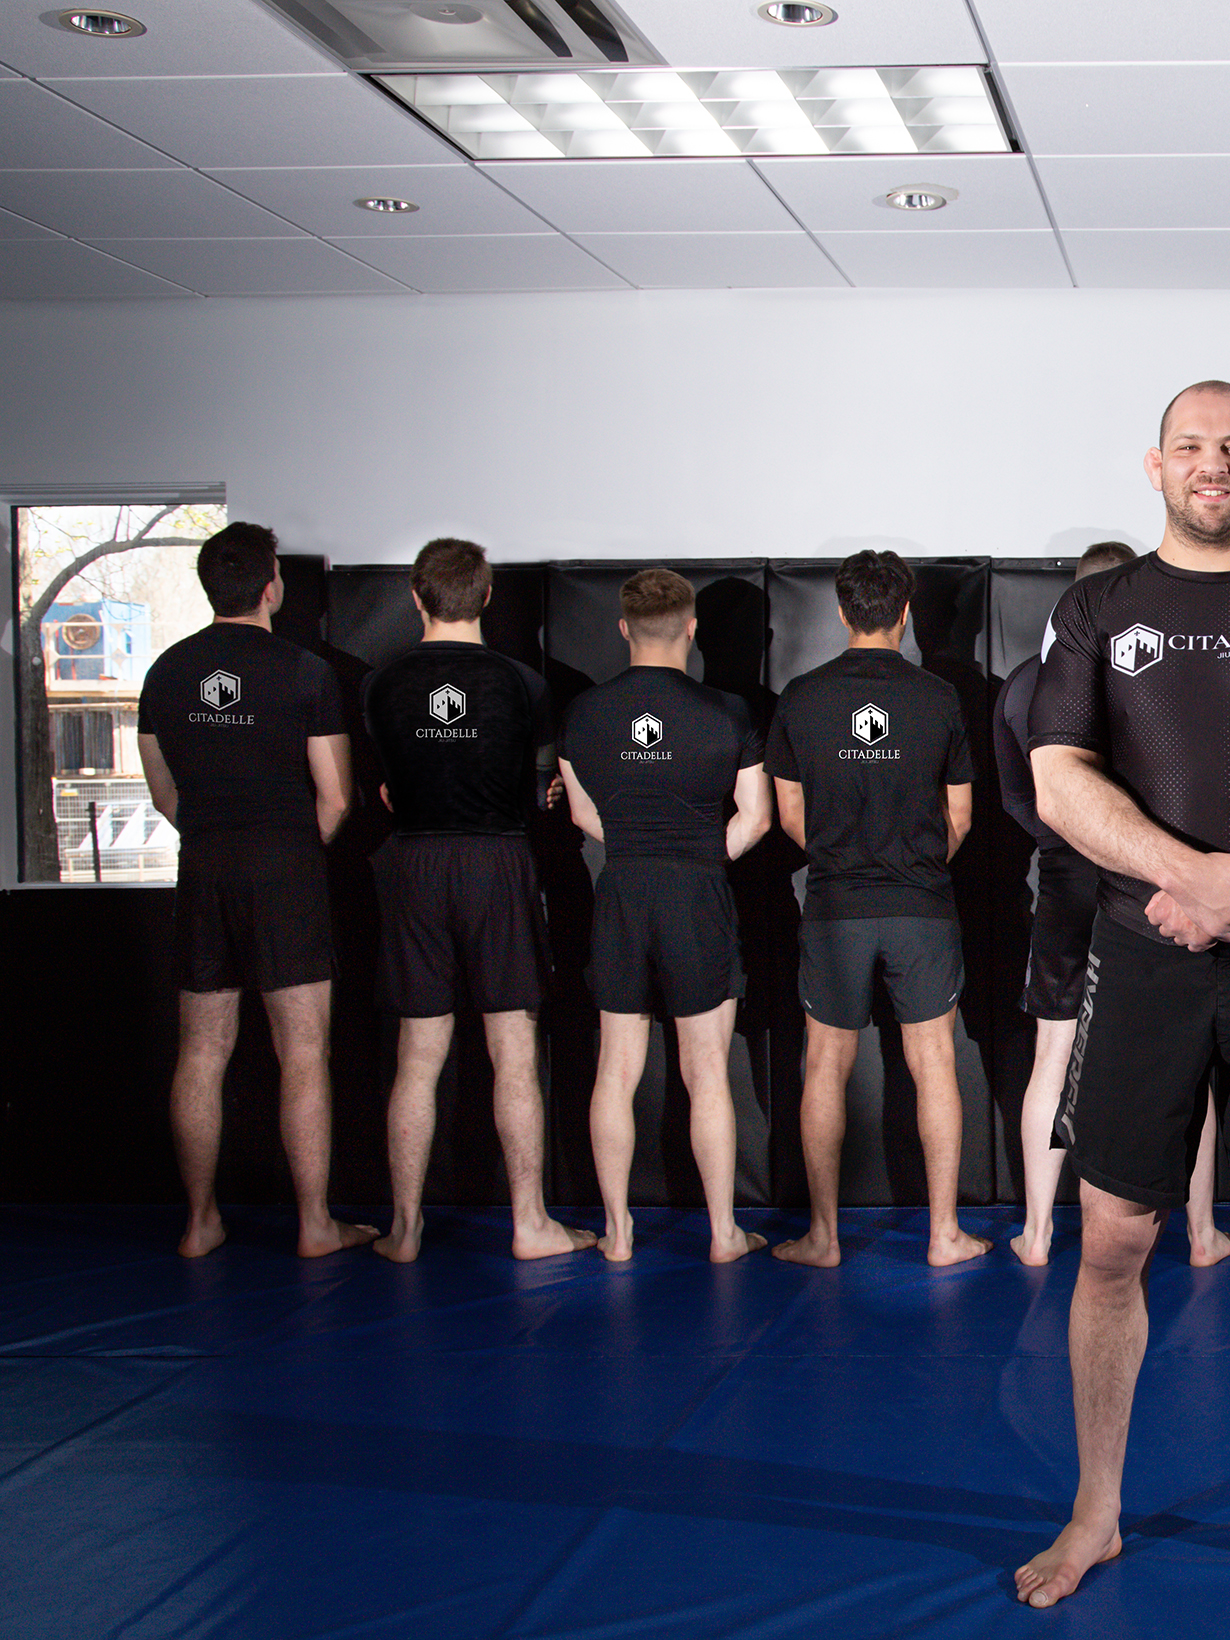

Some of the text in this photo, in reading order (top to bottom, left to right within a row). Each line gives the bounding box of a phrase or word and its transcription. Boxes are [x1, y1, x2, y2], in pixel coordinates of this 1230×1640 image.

[188, 712, 255, 725] CITADELLE
[415, 728, 478, 739] CITADELLE
[620, 751, 673, 760] CITADELLE
[838, 749, 901, 760] CITADELLE
